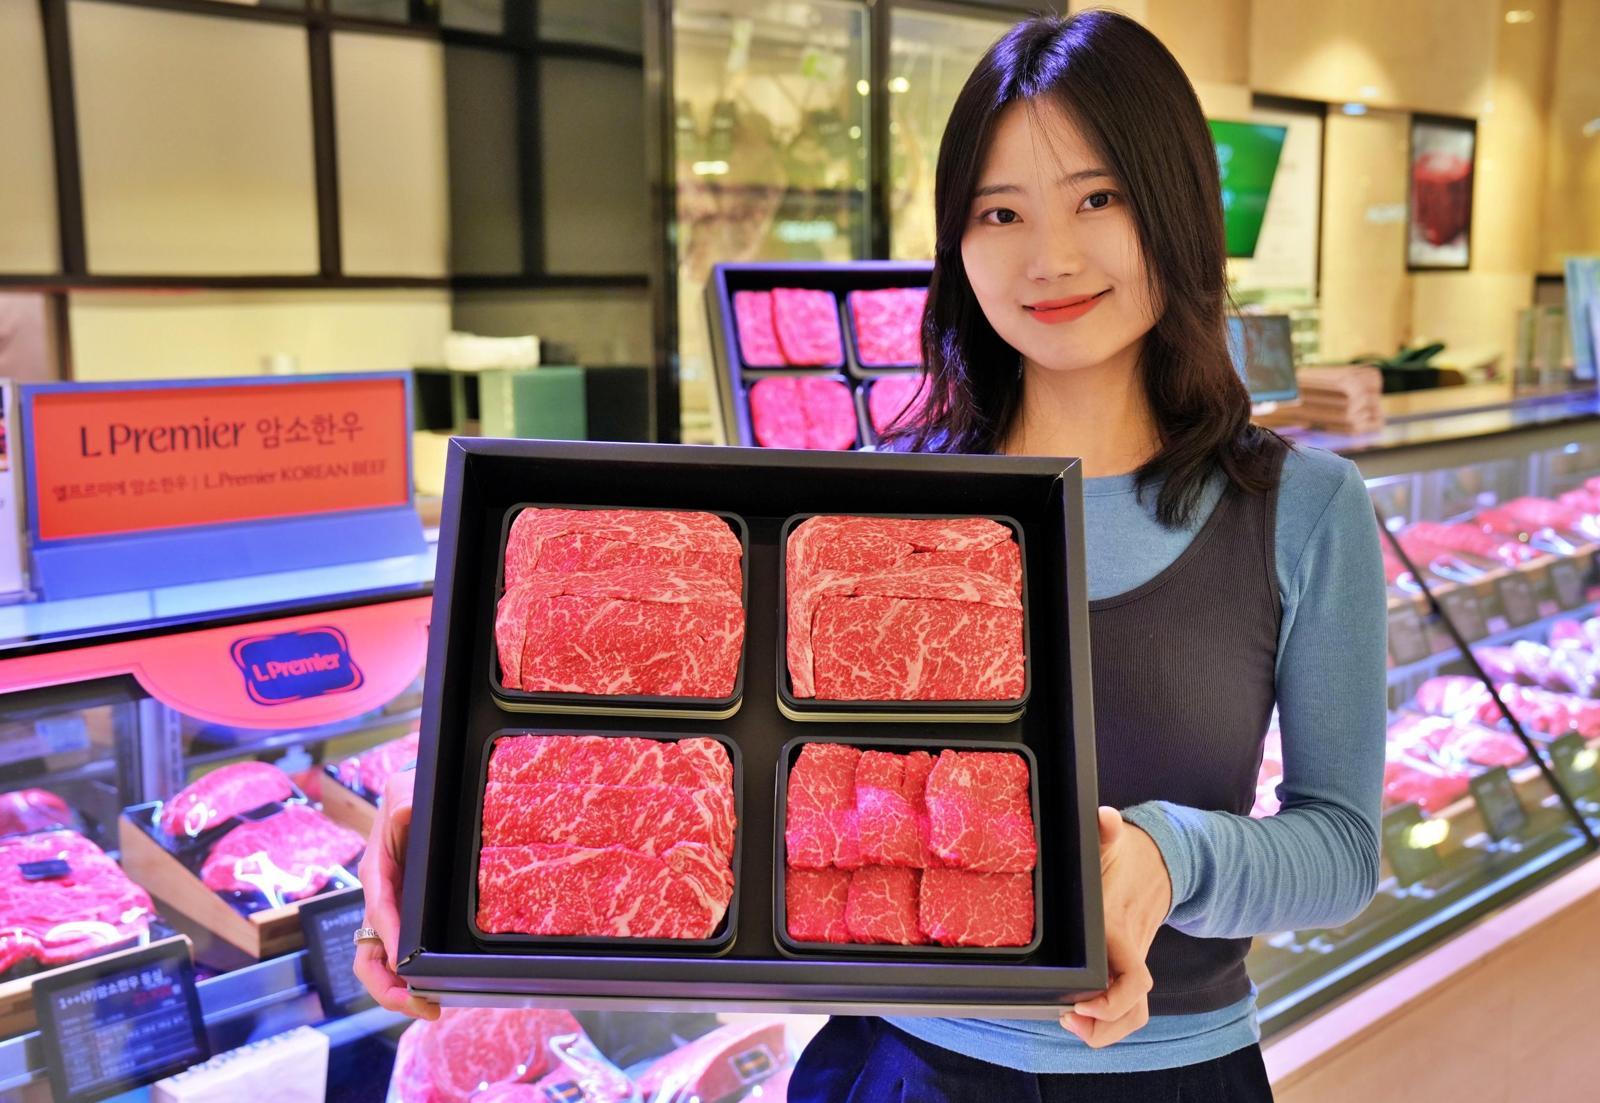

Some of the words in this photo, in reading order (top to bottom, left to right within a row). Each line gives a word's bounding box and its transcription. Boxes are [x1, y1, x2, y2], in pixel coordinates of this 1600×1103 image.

[80, 425, 102, 458] L
[109, 415, 246, 456] Premier
[256, 411, 364, 449] 암소한우
[279, 462, 350, 482] KOREAN
[351, 458, 387, 476] BEEF
[252, 652, 340, 682] L.Premier
